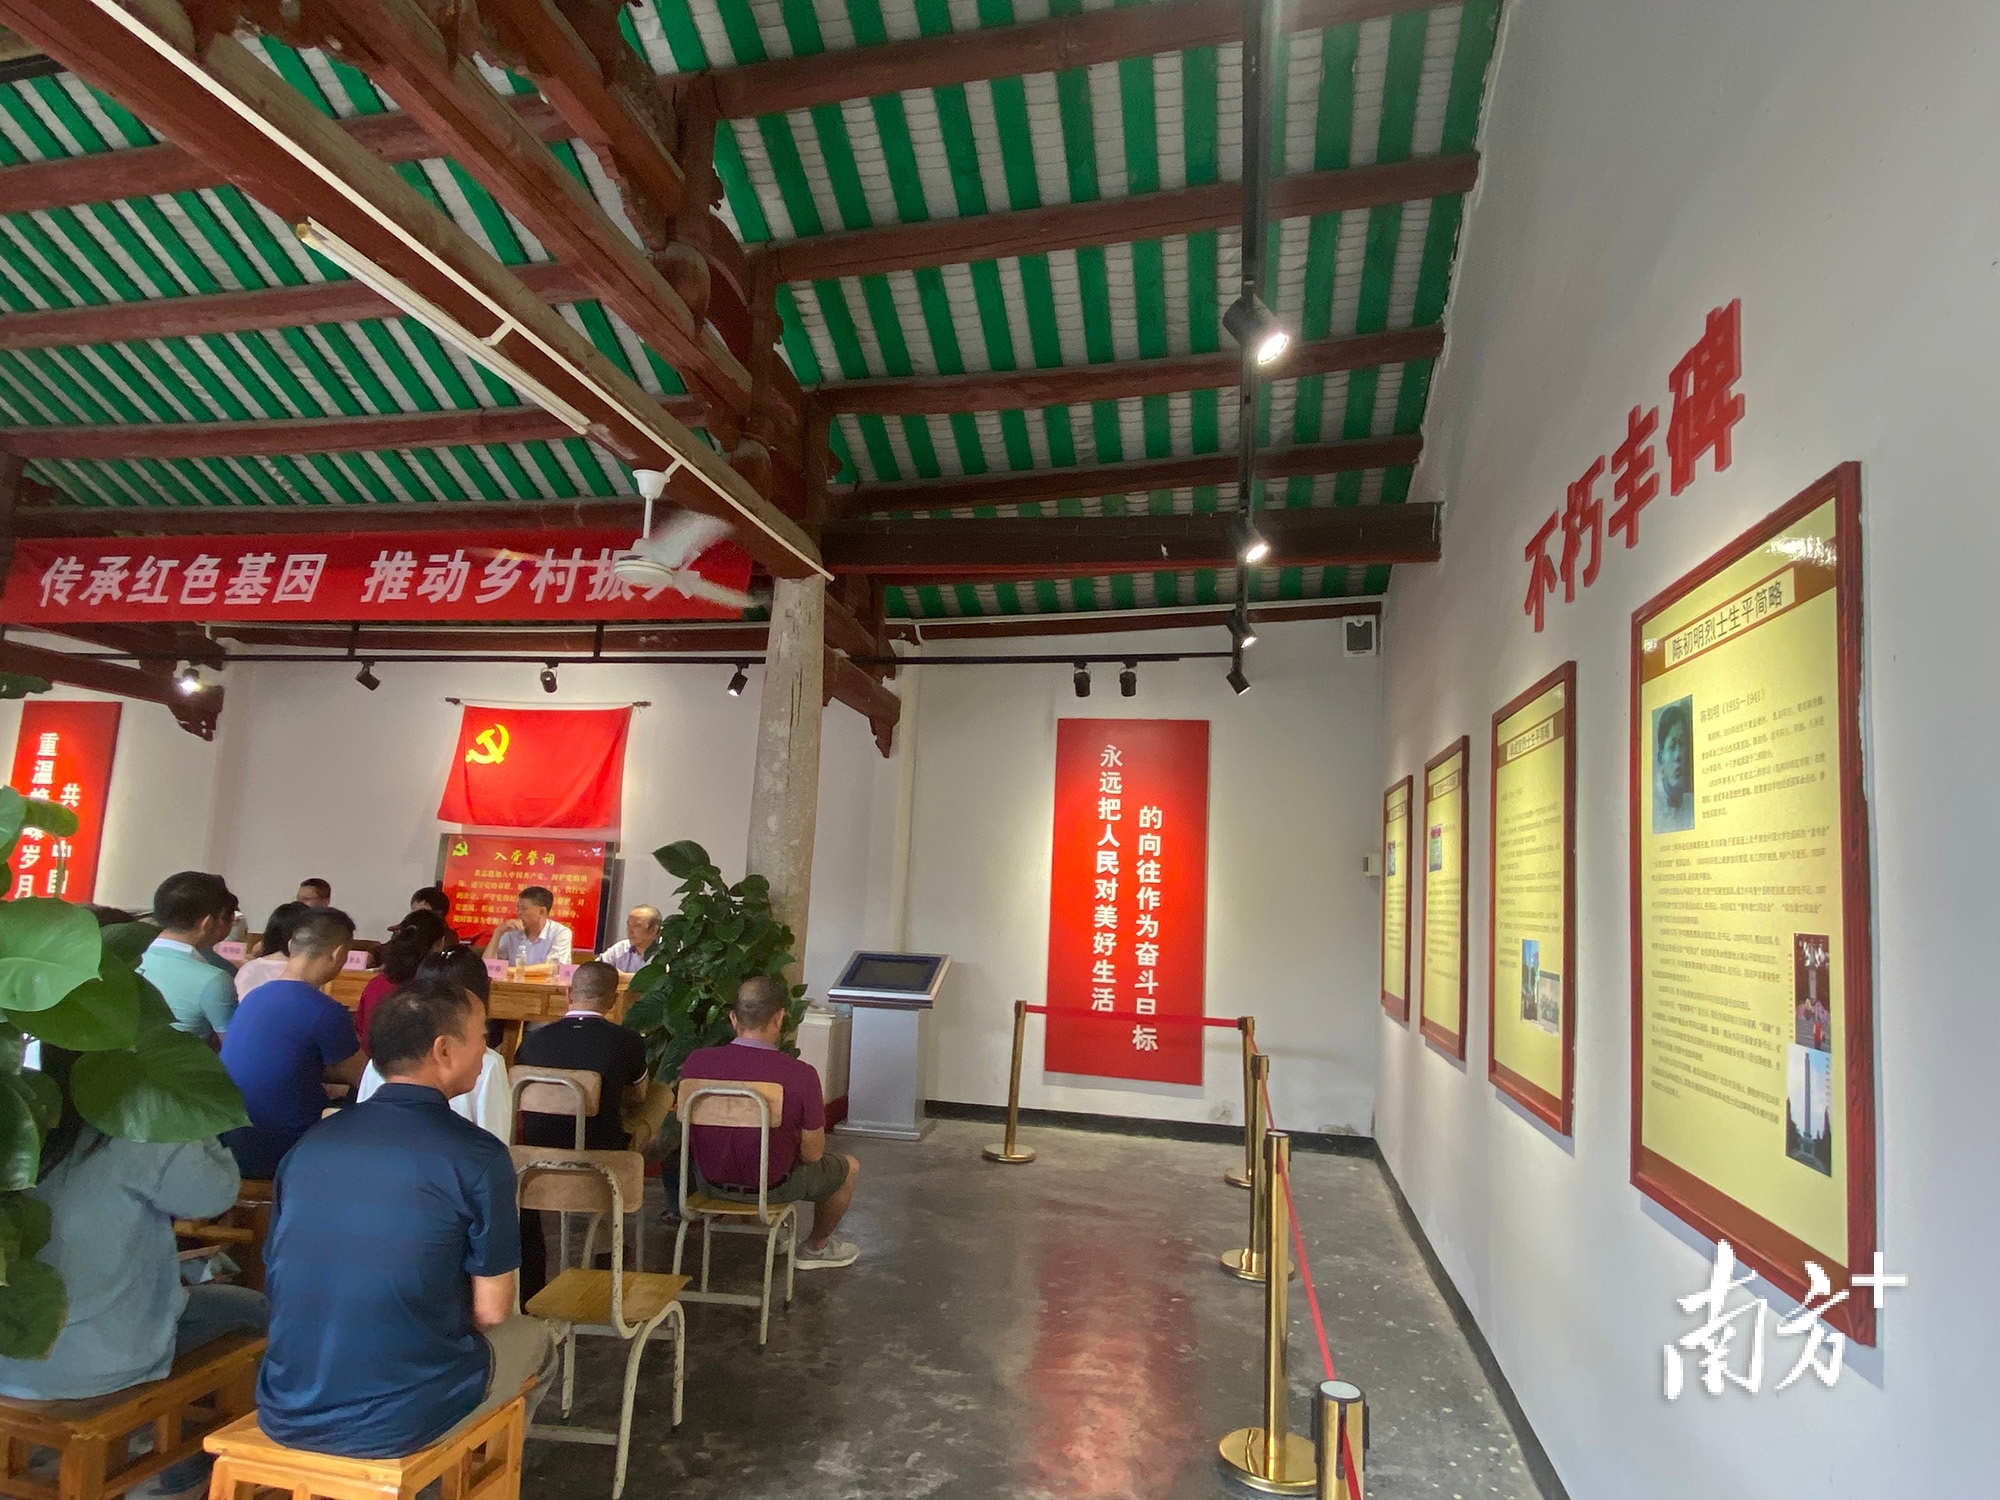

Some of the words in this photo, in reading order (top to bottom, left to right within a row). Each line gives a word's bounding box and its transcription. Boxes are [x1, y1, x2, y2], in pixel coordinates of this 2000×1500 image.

[1524, 298, 1745, 633] 不朽丰碑
[40, 552, 327, 607] 传承红色基因
[360, 548, 700, 603] 推动乡村振
[1672, 580, 1783, 661] 陈初明烈士生平简略
[494, 849, 556, 867] 入党誓词
[1091, 744, 1123, 1013] 永远把人民对美好生活
[1132, 806, 1163, 1052] 的向往作为奋斗目标
